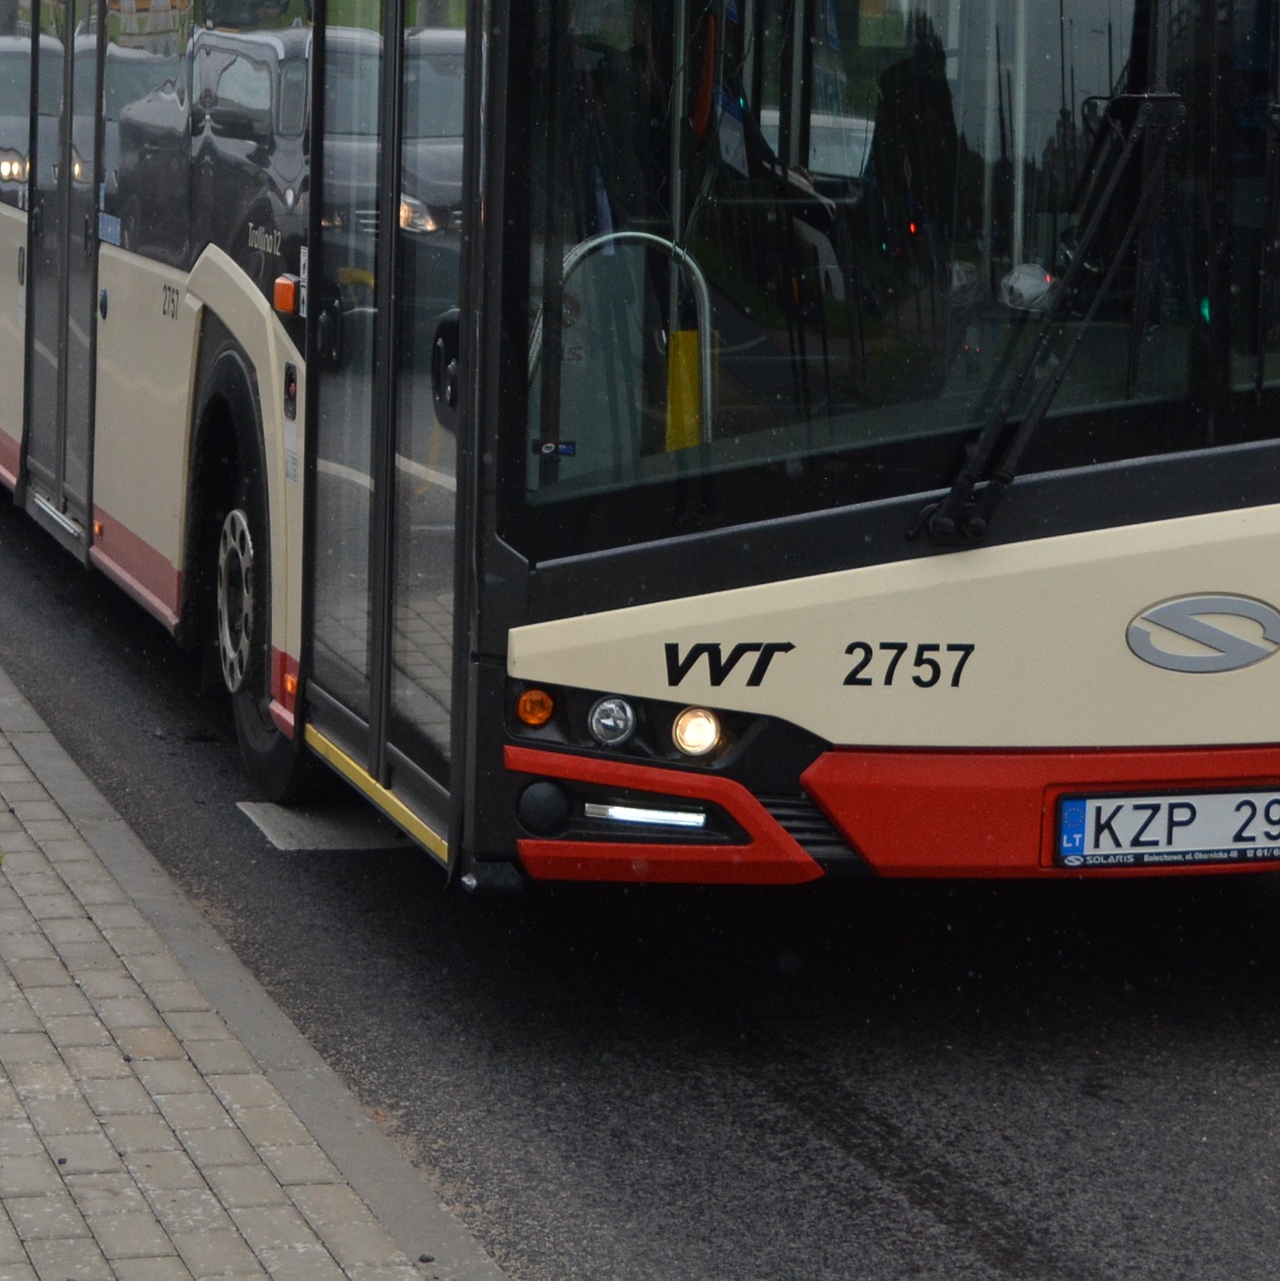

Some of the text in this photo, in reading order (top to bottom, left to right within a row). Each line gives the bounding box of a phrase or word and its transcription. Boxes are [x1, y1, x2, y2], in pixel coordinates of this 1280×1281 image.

[162, 283, 180, 321] 2757
[663, 640, 797, 687] VVT
[842, 640, 976, 689] 2757
[1062, 833, 1083, 848] LT
[1092, 801, 1197, 850] KZP
[1085, 854, 1135, 865] SOLARIS
